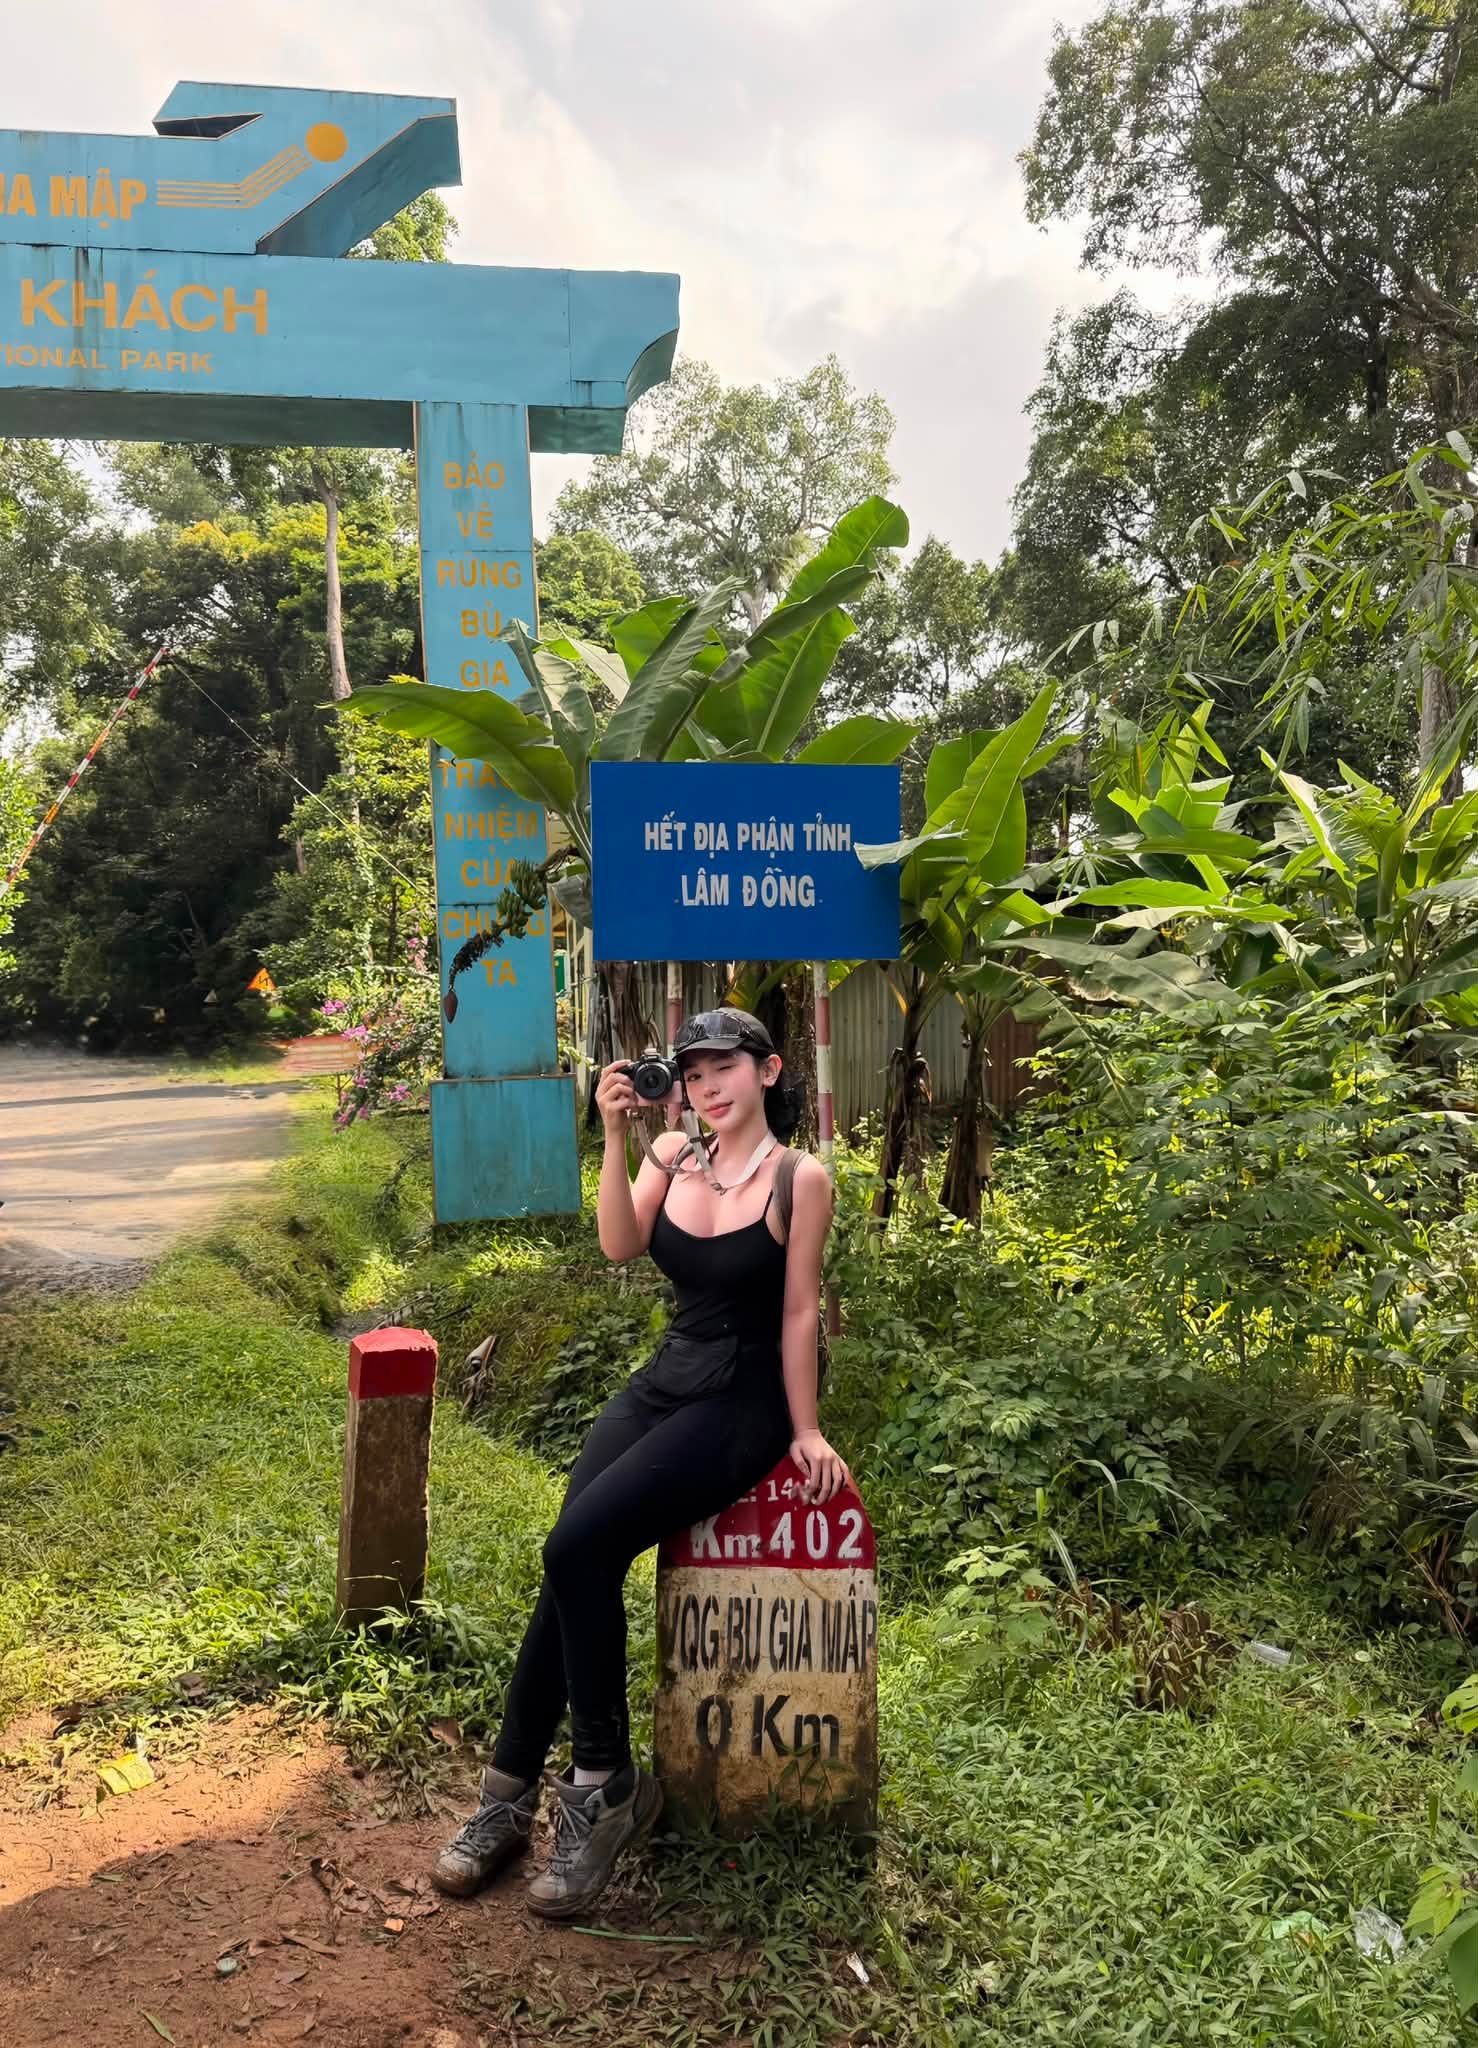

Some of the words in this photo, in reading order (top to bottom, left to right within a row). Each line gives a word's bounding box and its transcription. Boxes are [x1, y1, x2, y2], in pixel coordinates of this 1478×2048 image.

[50, 167, 147, 229] MẬP
[21, 268, 268, 336] KHÁCH
[0, 344, 110, 370] IONAL
[121, 348, 214, 374] PARK
[457, 502, 493, 544] VỆ
[460, 660, 509, 687] GIA
[444, 803, 538, 845] NHIỆM
[645, 811, 686, 850] HẾT
[694, 822, 729, 858] ĐỊA
[737, 816, 794, 859] PHẬN
[803, 812, 851, 851] TỈNH
[681, 867, 729, 906] LÂM
[742, 867, 815, 908] ĐỒNG
[481, 960, 517, 987] TA
[690, 1513, 762, 1558] Km
[768, 1508, 863, 1559] 402
[726, 1584, 763, 1673] BÙ
[769, 1595, 813, 1673] GIA
[751, 1694, 840, 1758] Km
